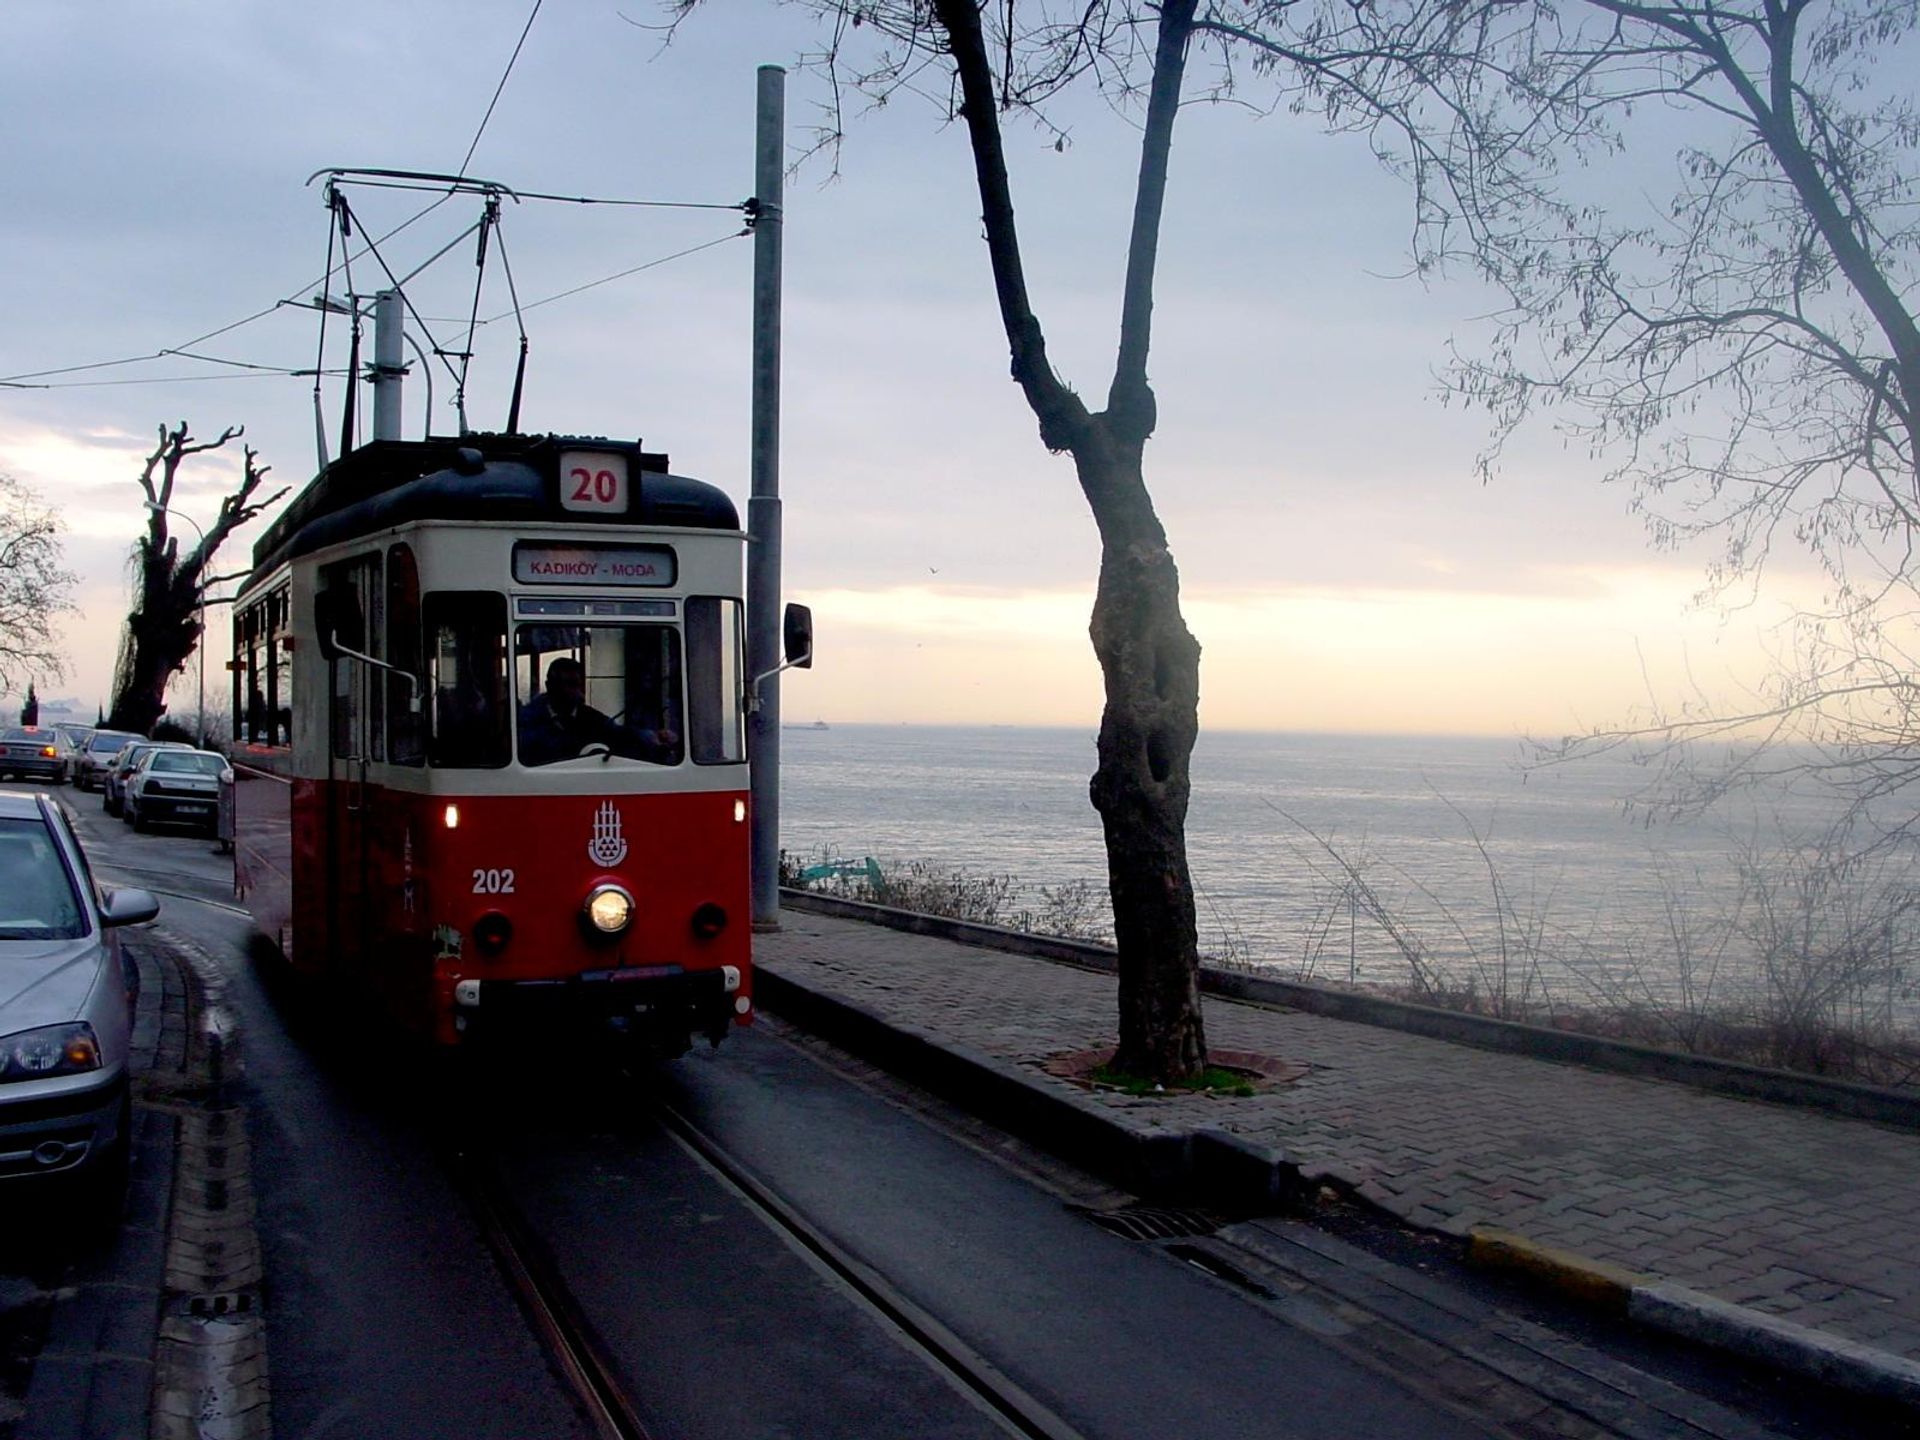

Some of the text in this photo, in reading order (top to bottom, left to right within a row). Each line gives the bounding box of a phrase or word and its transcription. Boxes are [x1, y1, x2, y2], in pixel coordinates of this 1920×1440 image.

[570, 468, 616, 503] 20
[612, 565, 656, 577] MODA
[473, 869, 514, 893] 202
